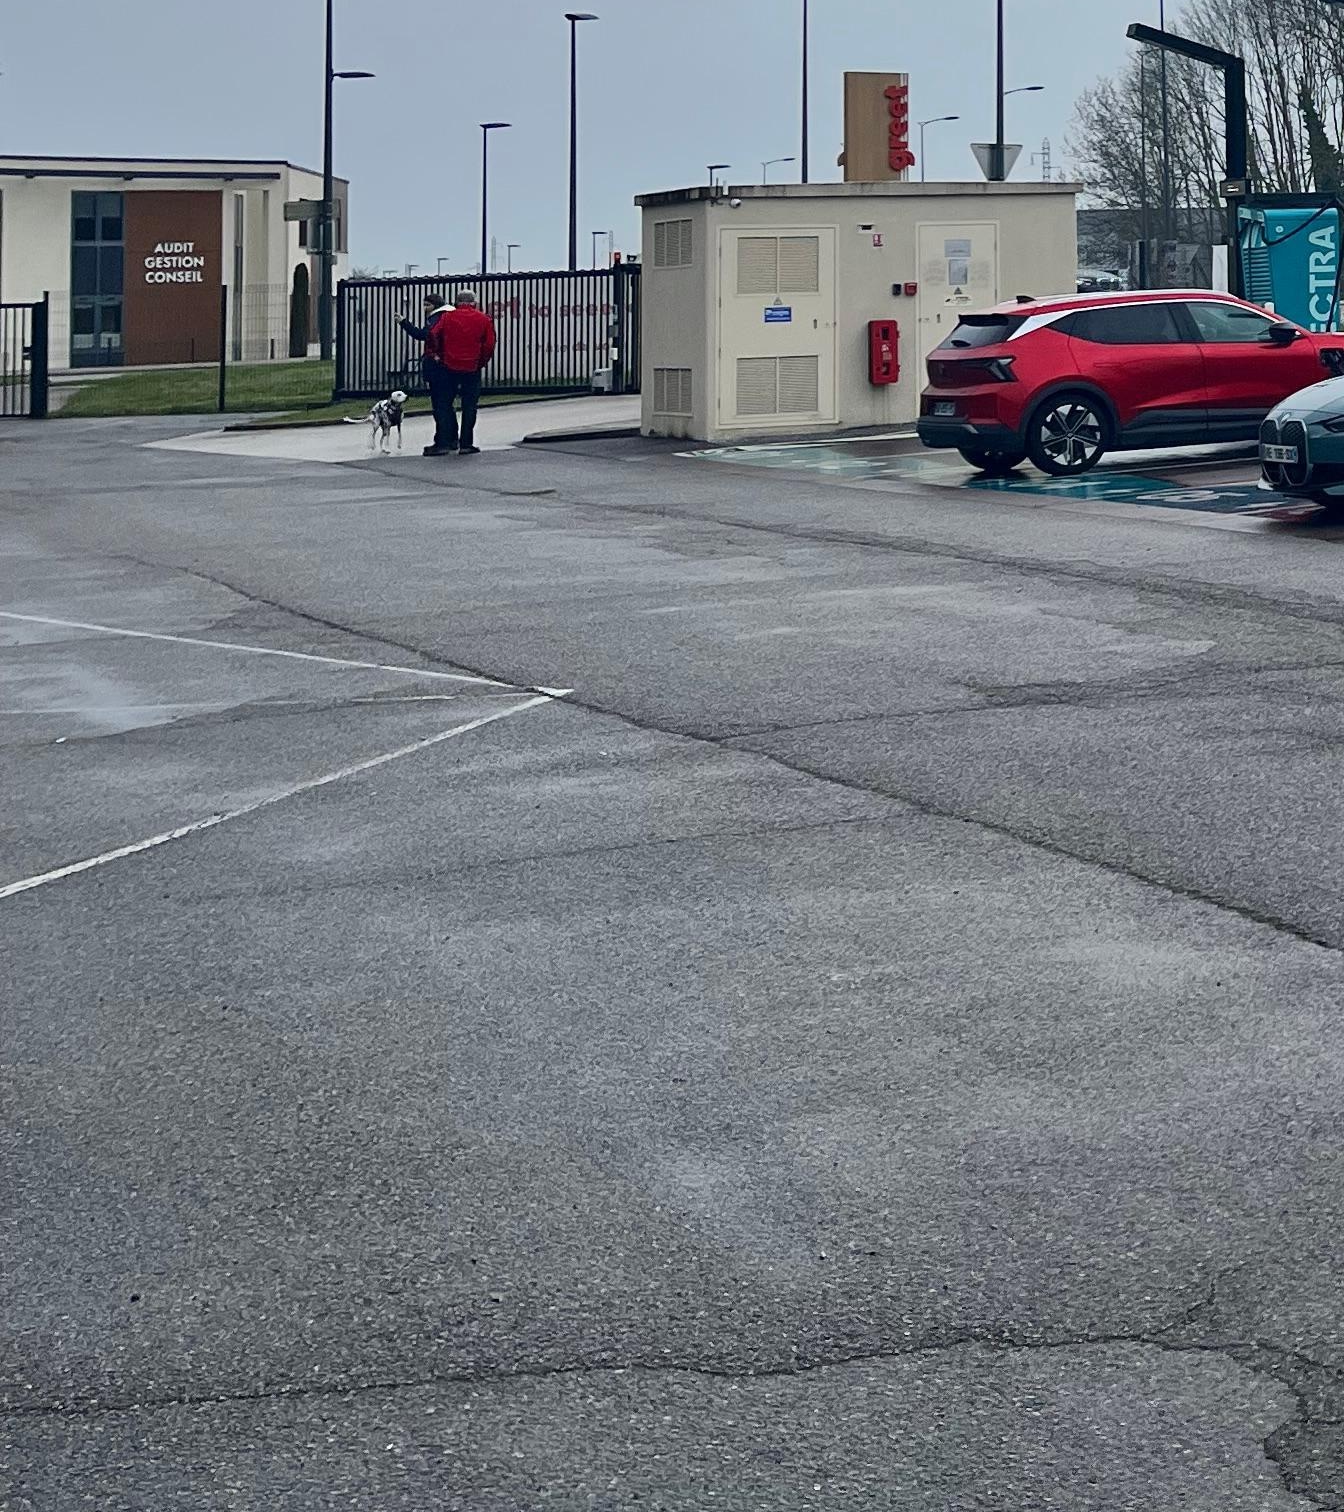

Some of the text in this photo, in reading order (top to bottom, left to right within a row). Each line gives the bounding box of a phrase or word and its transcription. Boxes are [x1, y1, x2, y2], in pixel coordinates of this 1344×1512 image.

[883, 85, 915, 172] greet
[154, 242, 194, 253] AUDIT
[144, 256, 204, 268] GESTION
[145, 271, 203, 283] CONSEIL
